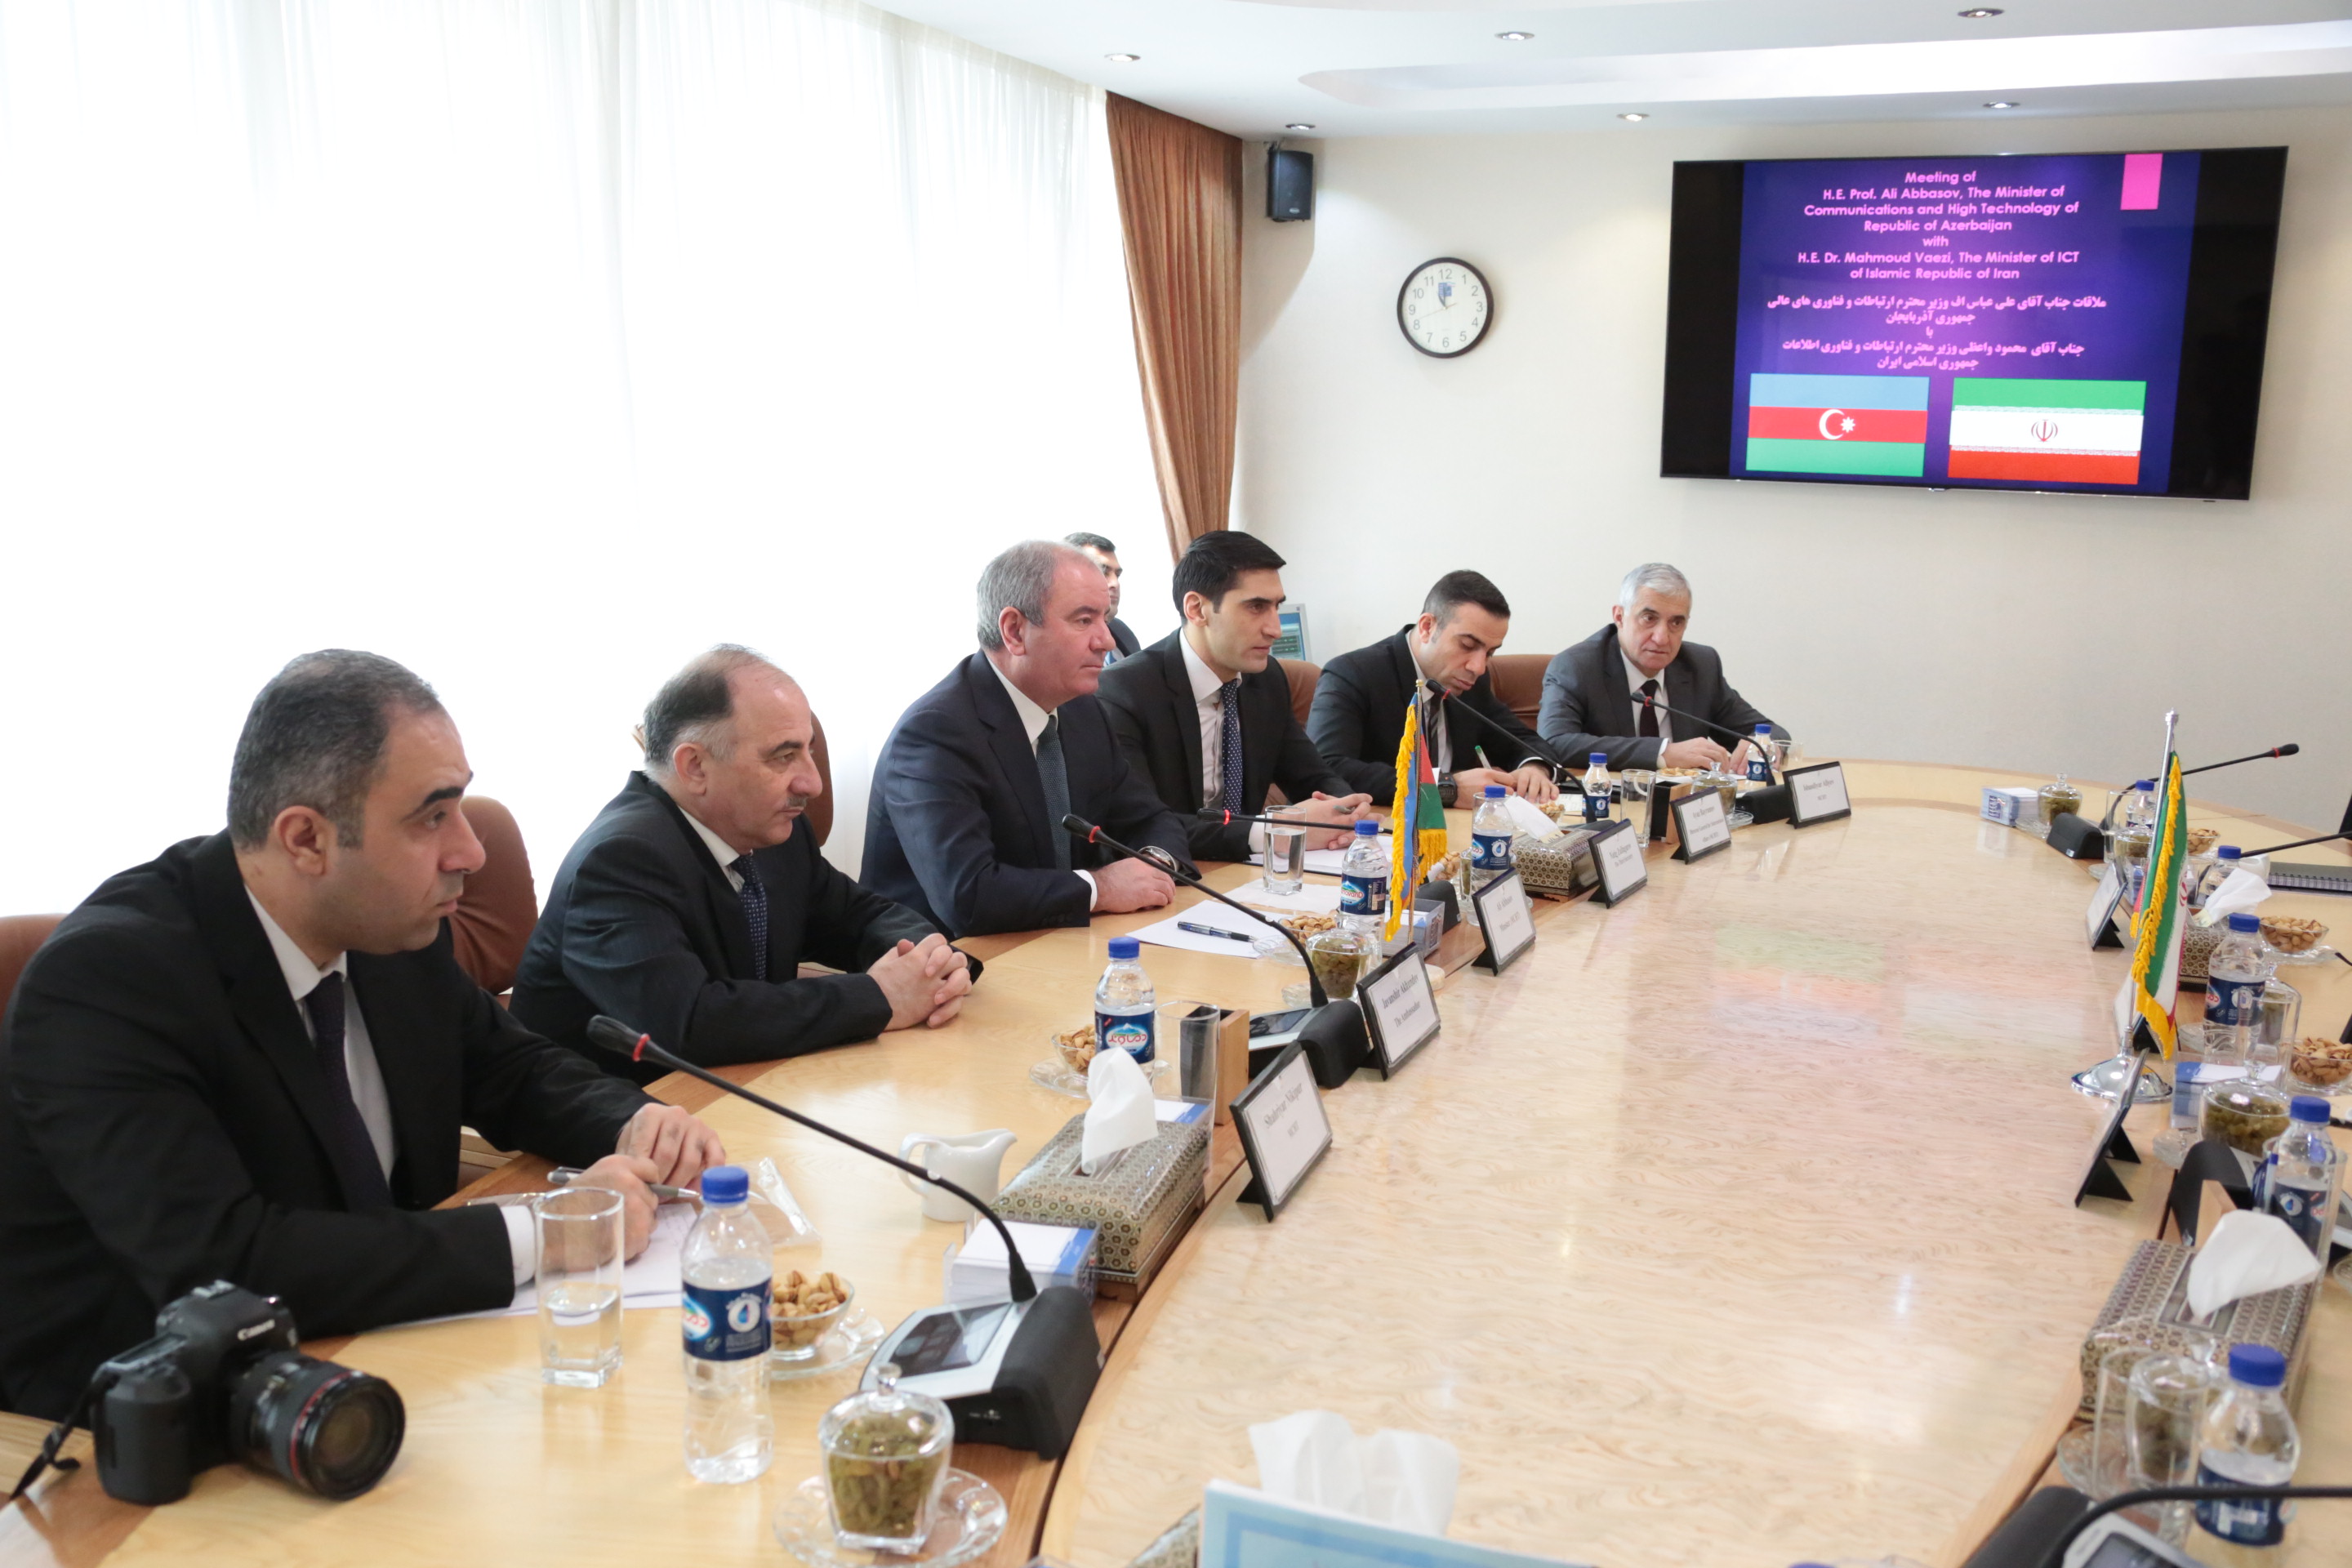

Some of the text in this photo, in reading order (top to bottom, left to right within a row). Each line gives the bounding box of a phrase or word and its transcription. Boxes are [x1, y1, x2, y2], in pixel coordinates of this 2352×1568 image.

[1904, 171, 1976, 185] Meeting of
[1823, 185, 2065, 200] H.E. Prof. Ali Abbasov, The Minister of
[1804, 201, 2079, 216] Communications and High Technology of
[1864, 219, 2012, 234] Republic of Azerbaijan
[1922, 236, 1949, 247] with
[1798, 252, 2079, 265] H.E. Dr. Mahmoud Vaezi, The Minister of ICT
[1439, 269, 1452, 279] 12
[1462, 274, 1467, 284] 1
[1850, 268, 2020, 281] of Islamic Republic of Iran
[1424, 276, 1434, 287] 11
[1413, 287, 1424, 299] 10
[1472, 285, 1478, 296] 2
[1477, 301, 1483, 312] 3
[1767, 295, 2106, 310] ملاقات جناب آقای علی عباس اف وزیر محترم ارتباطات و فناوری های عالی
[1409, 304, 1415, 315] 9
[1472, 317, 1478, 327] 4
[1886, 310, 1976, 325] جمهوری آذربایجان
[1414, 319, 1420, 330] 8
[1427, 332, 1432, 343] 7
[1459, 331, 1467, 341] 5
[1926, 326, 1934, 338] با
[1442, 337, 1450, 347] 6
[1782, 339, 2085, 357] جناب آقای محمود واعظی وزیر محترم ارتباطات و فناوری اطلاعات
[1878, 356, 1979, 371] جمهوری اسلامی ایران
